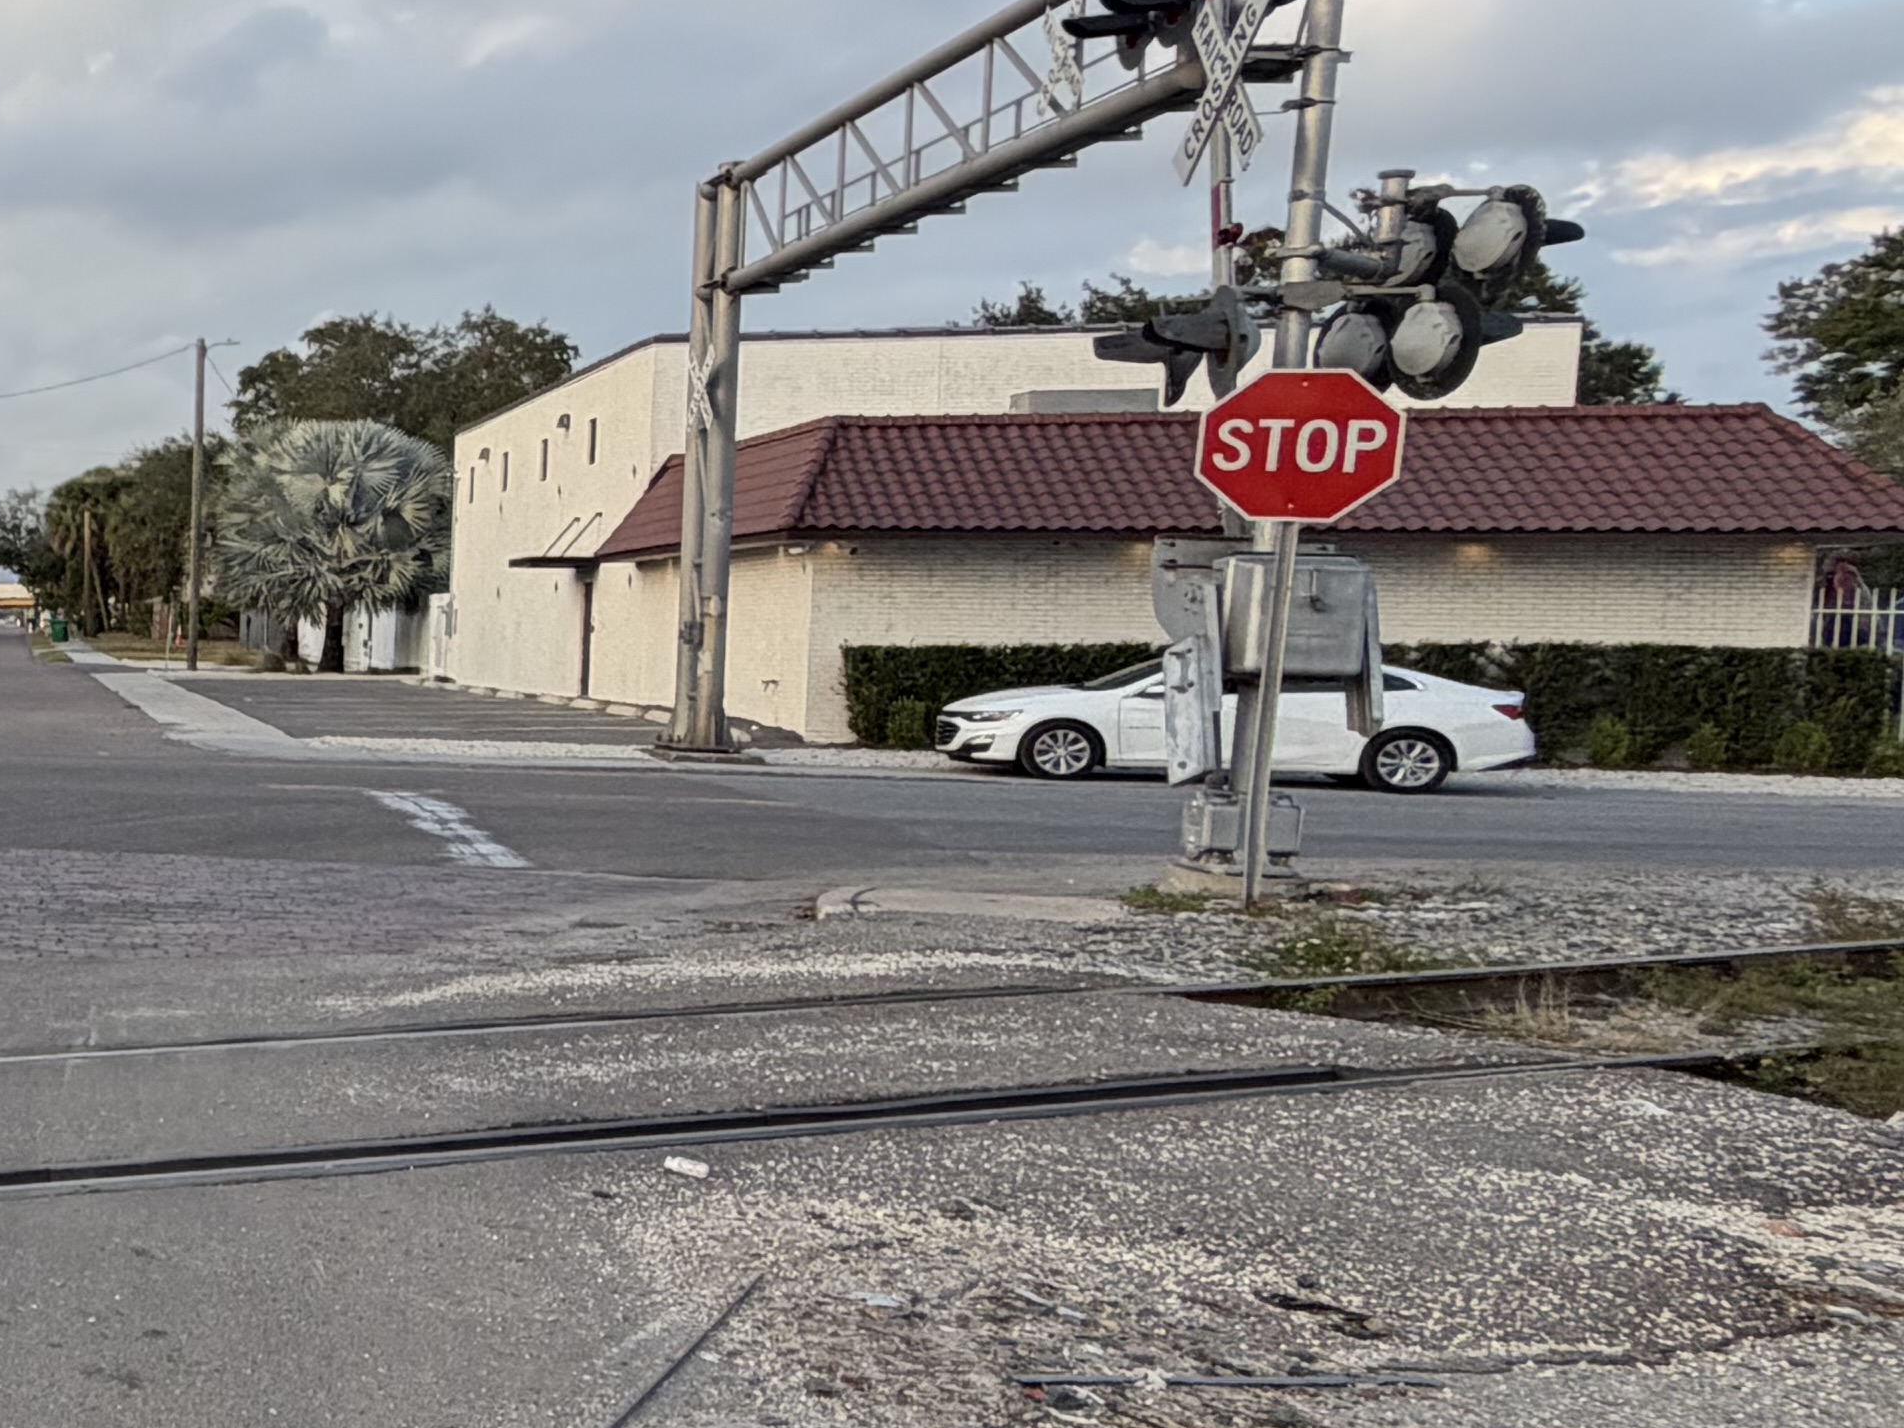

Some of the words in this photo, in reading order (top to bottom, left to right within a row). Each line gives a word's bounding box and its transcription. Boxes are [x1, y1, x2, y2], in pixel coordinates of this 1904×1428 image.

[1184, 3, 1257, 160] CROSSING
[1196, 11, 1221, 75] RAIL
[1225, 90, 1254, 156] ROAD
[1212, 418, 1388, 473] STOP
